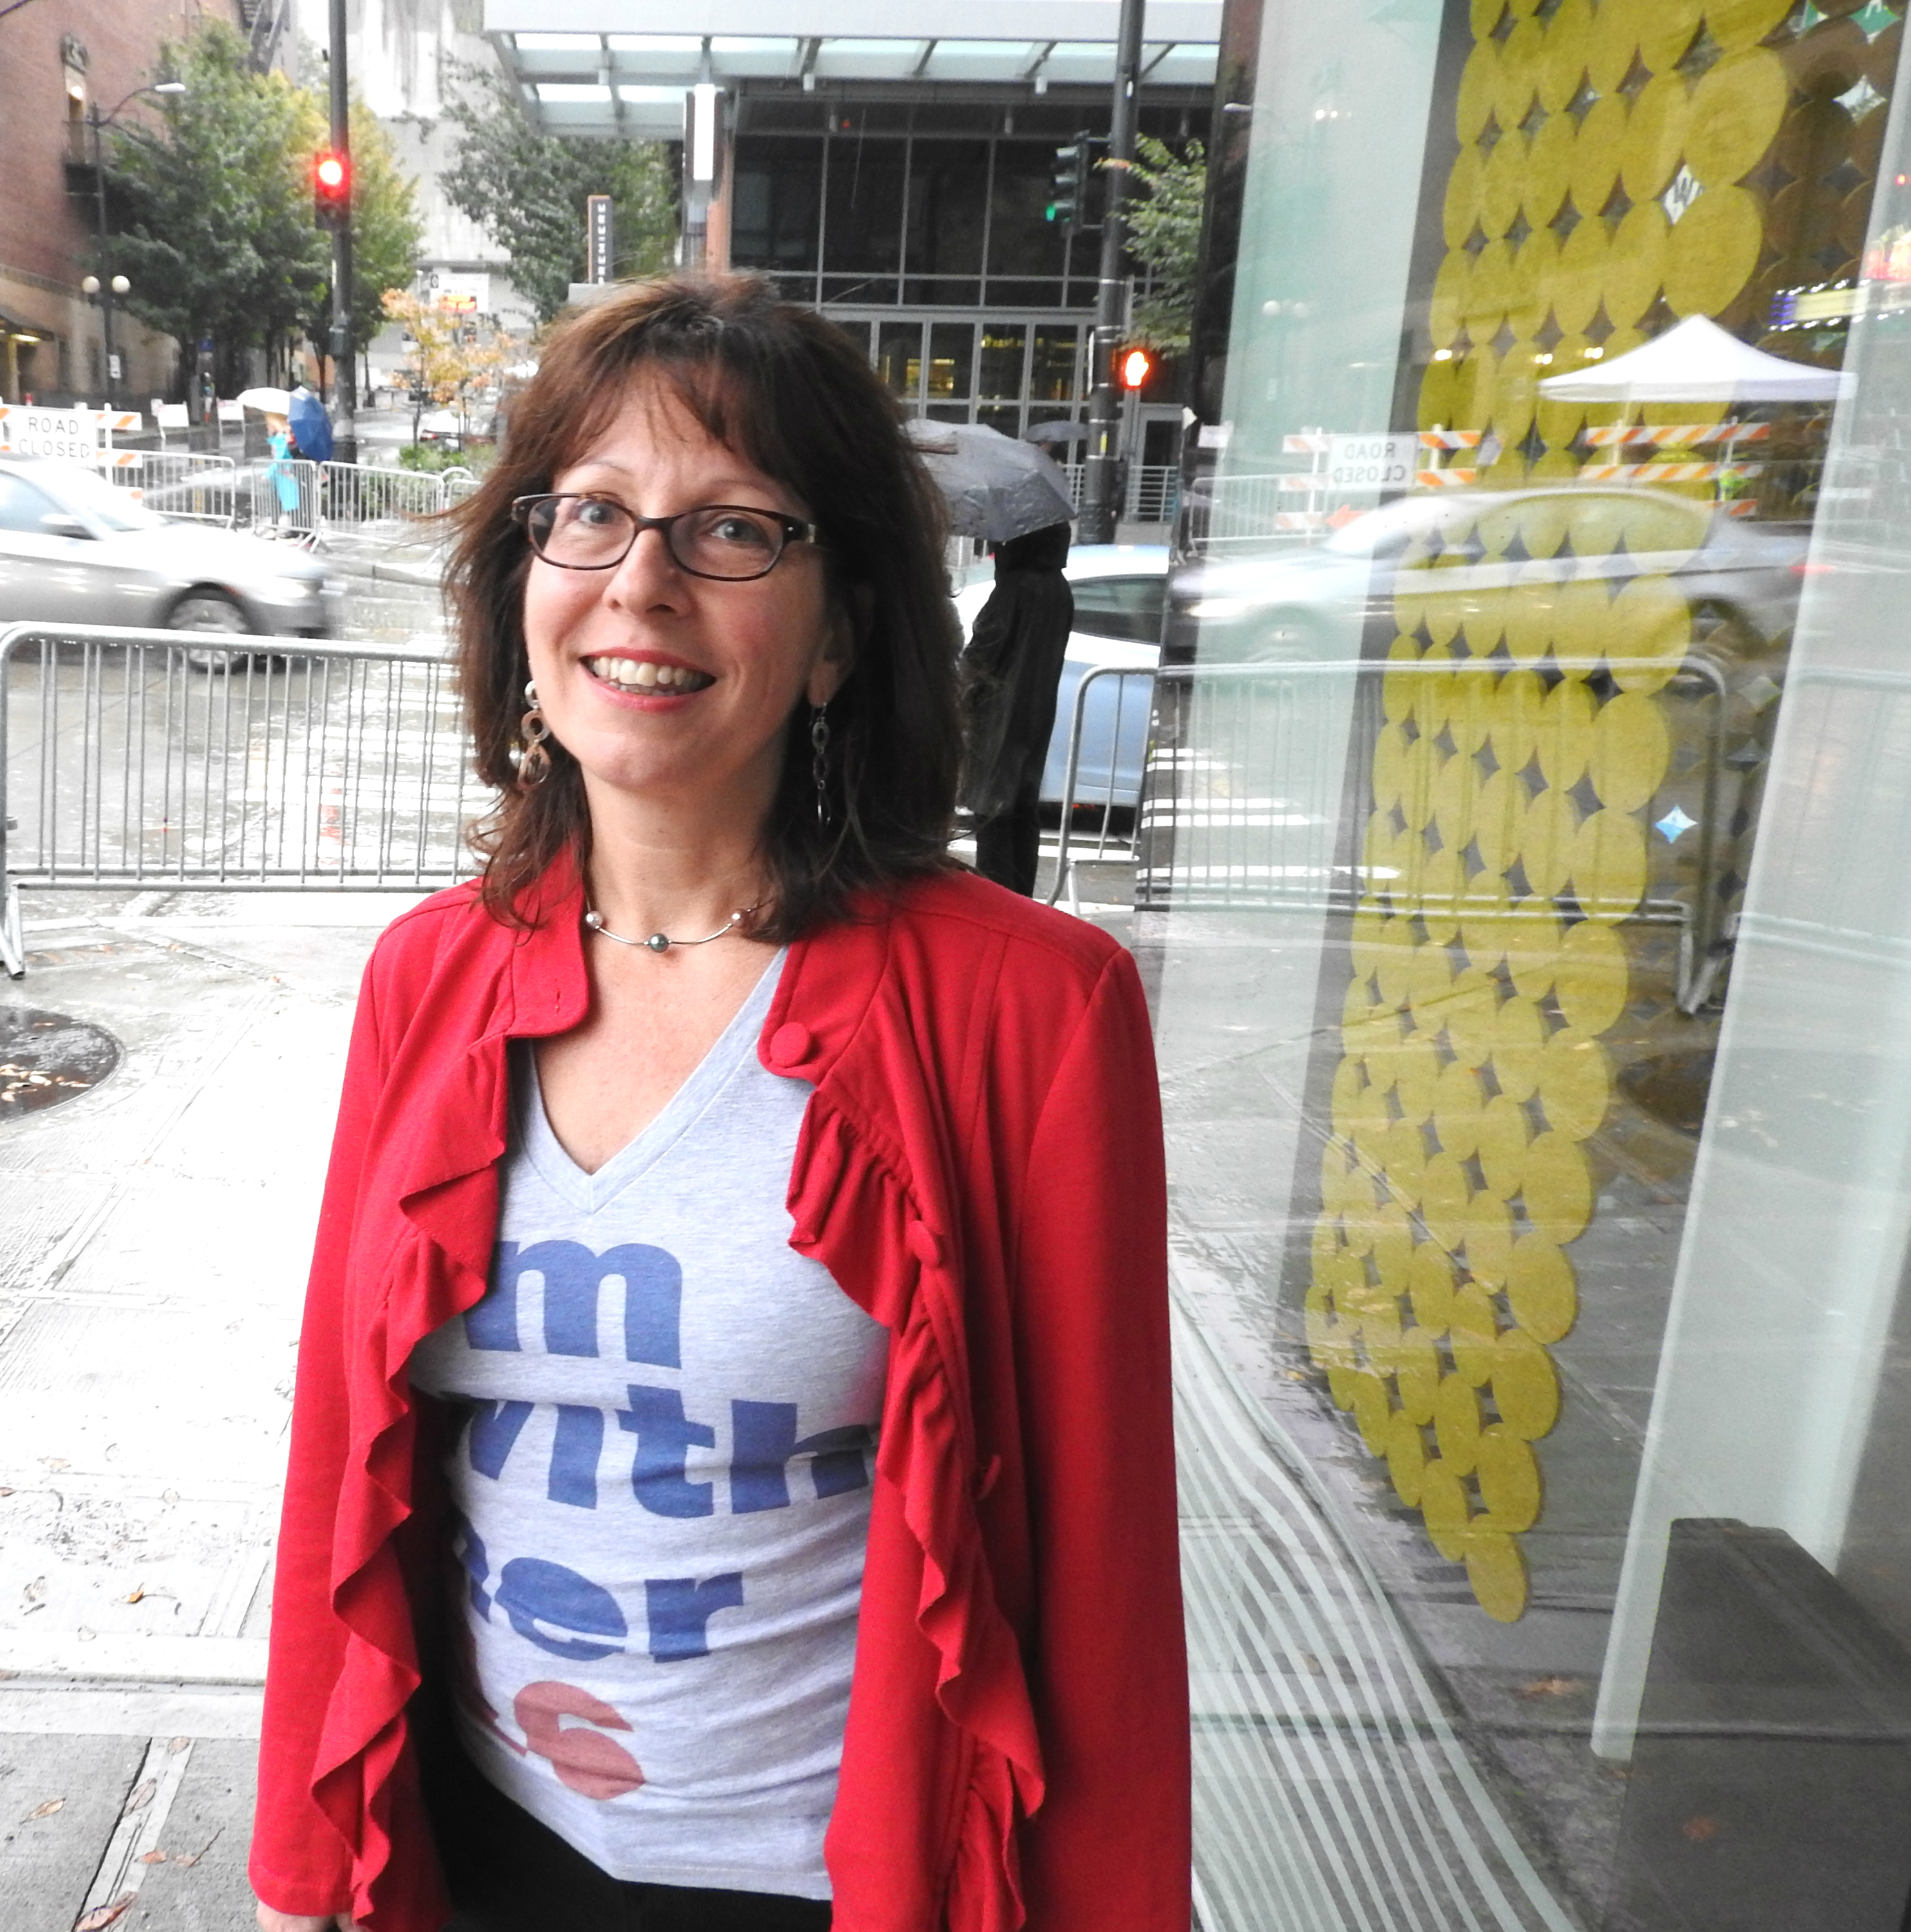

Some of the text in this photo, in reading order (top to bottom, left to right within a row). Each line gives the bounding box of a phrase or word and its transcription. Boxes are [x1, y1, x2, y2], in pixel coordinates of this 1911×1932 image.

[596, 203, 606, 285] PREMIERE
[19, 439, 90, 458] CLOSED
[28, 416, 79, 435] ROAD
[461, 1513, 743, 1663] er
